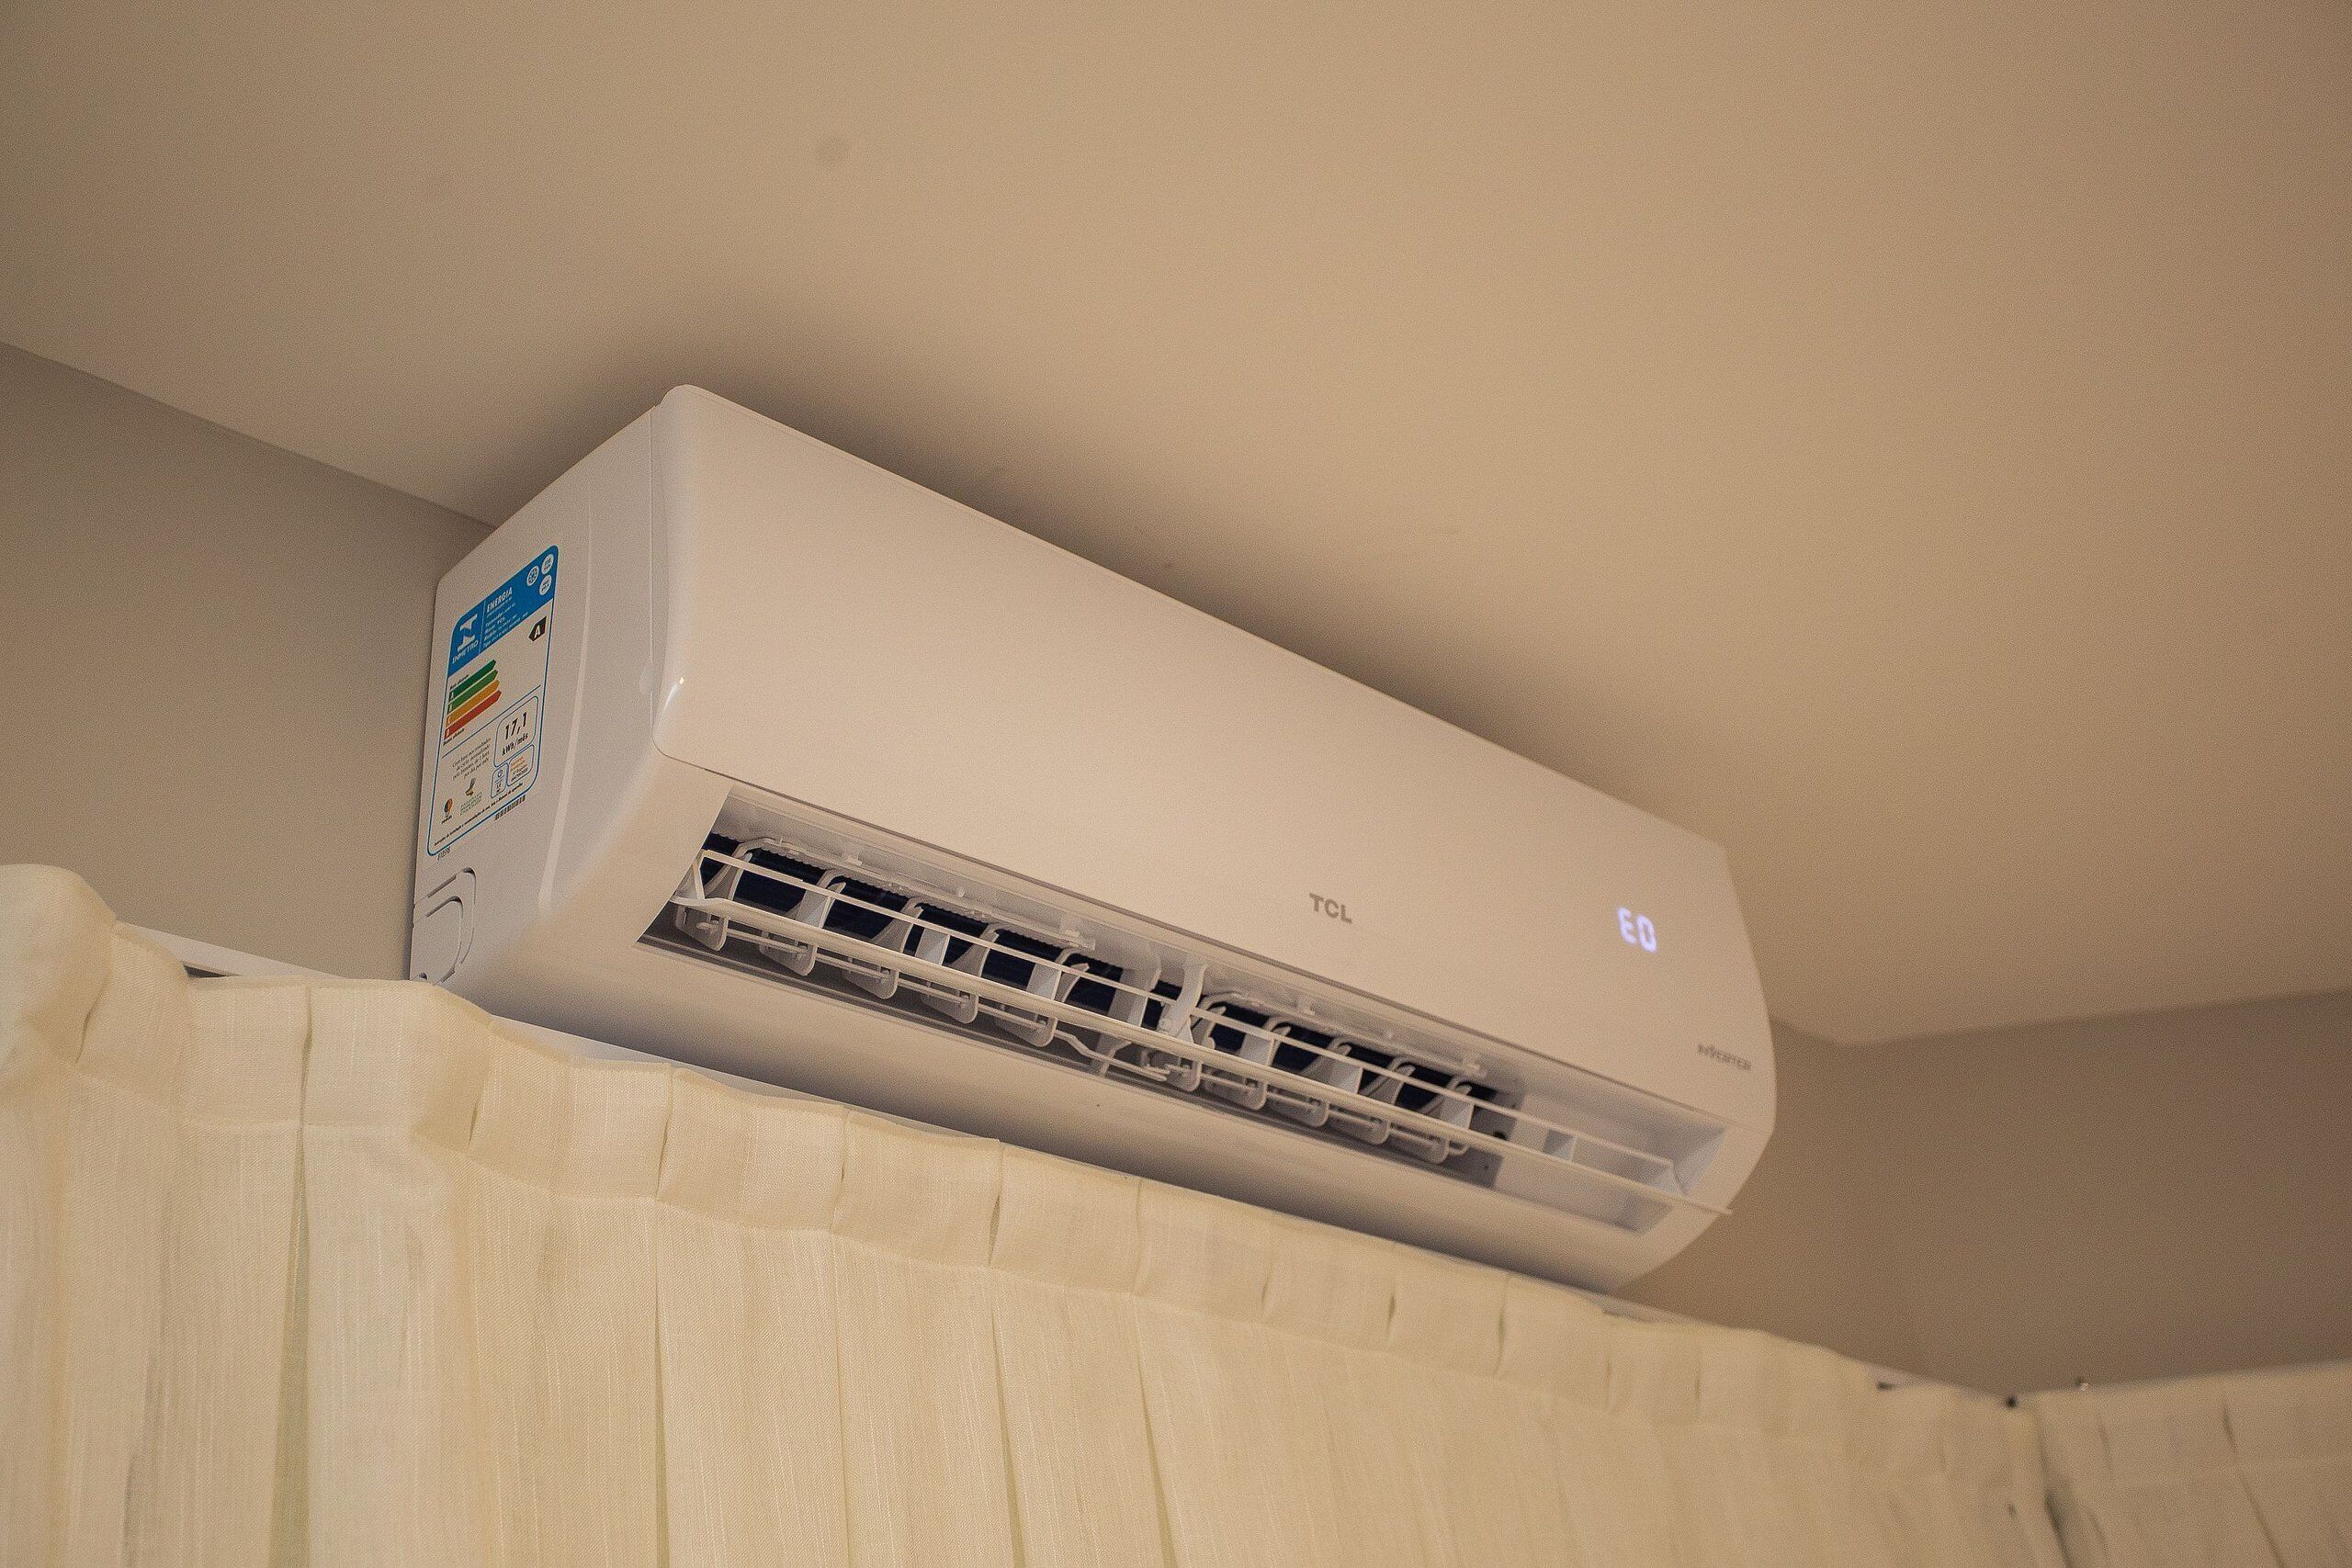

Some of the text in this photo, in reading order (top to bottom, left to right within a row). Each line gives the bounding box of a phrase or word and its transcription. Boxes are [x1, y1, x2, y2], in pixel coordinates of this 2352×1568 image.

[486, 587, 513, 614] ENERGIA
[534, 625, 541, 638] A
[452, 640, 479, 664] INMETRO
[505, 711, 527, 740] 17,1
[1309, 892, 1352, 924] TCL
